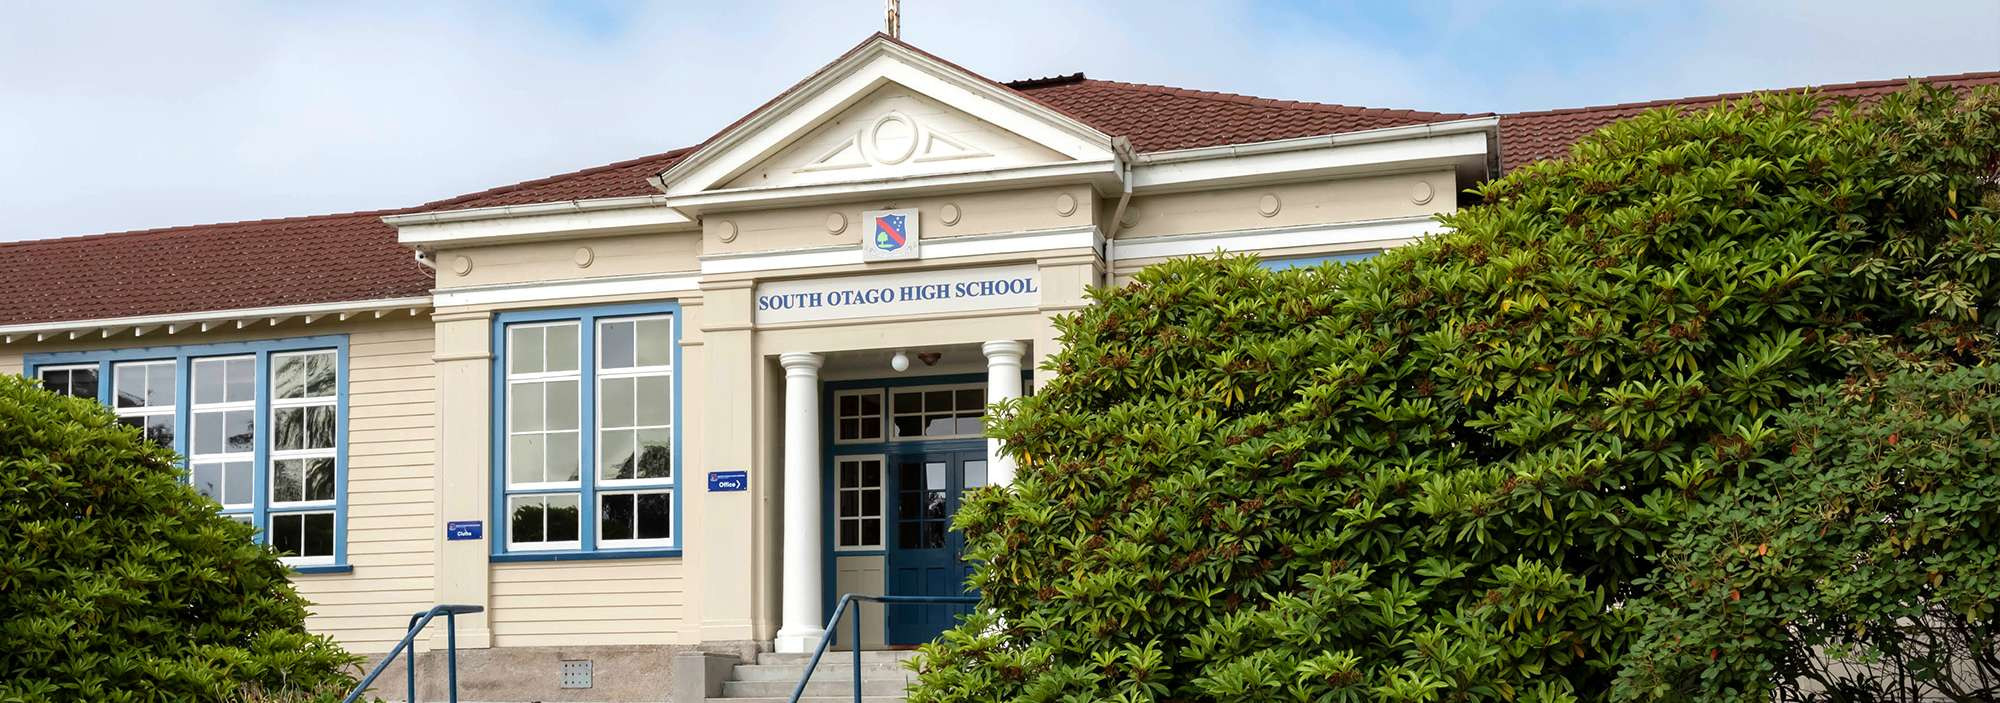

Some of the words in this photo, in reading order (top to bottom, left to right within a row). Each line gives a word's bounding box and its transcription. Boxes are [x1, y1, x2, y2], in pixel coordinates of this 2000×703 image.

[759, 292, 822, 311] SOUTH
[827, 288, 895, 306] OTAGO
[900, 284, 951, 302] HIGH
[955, 278, 1038, 299] SCHOOL
